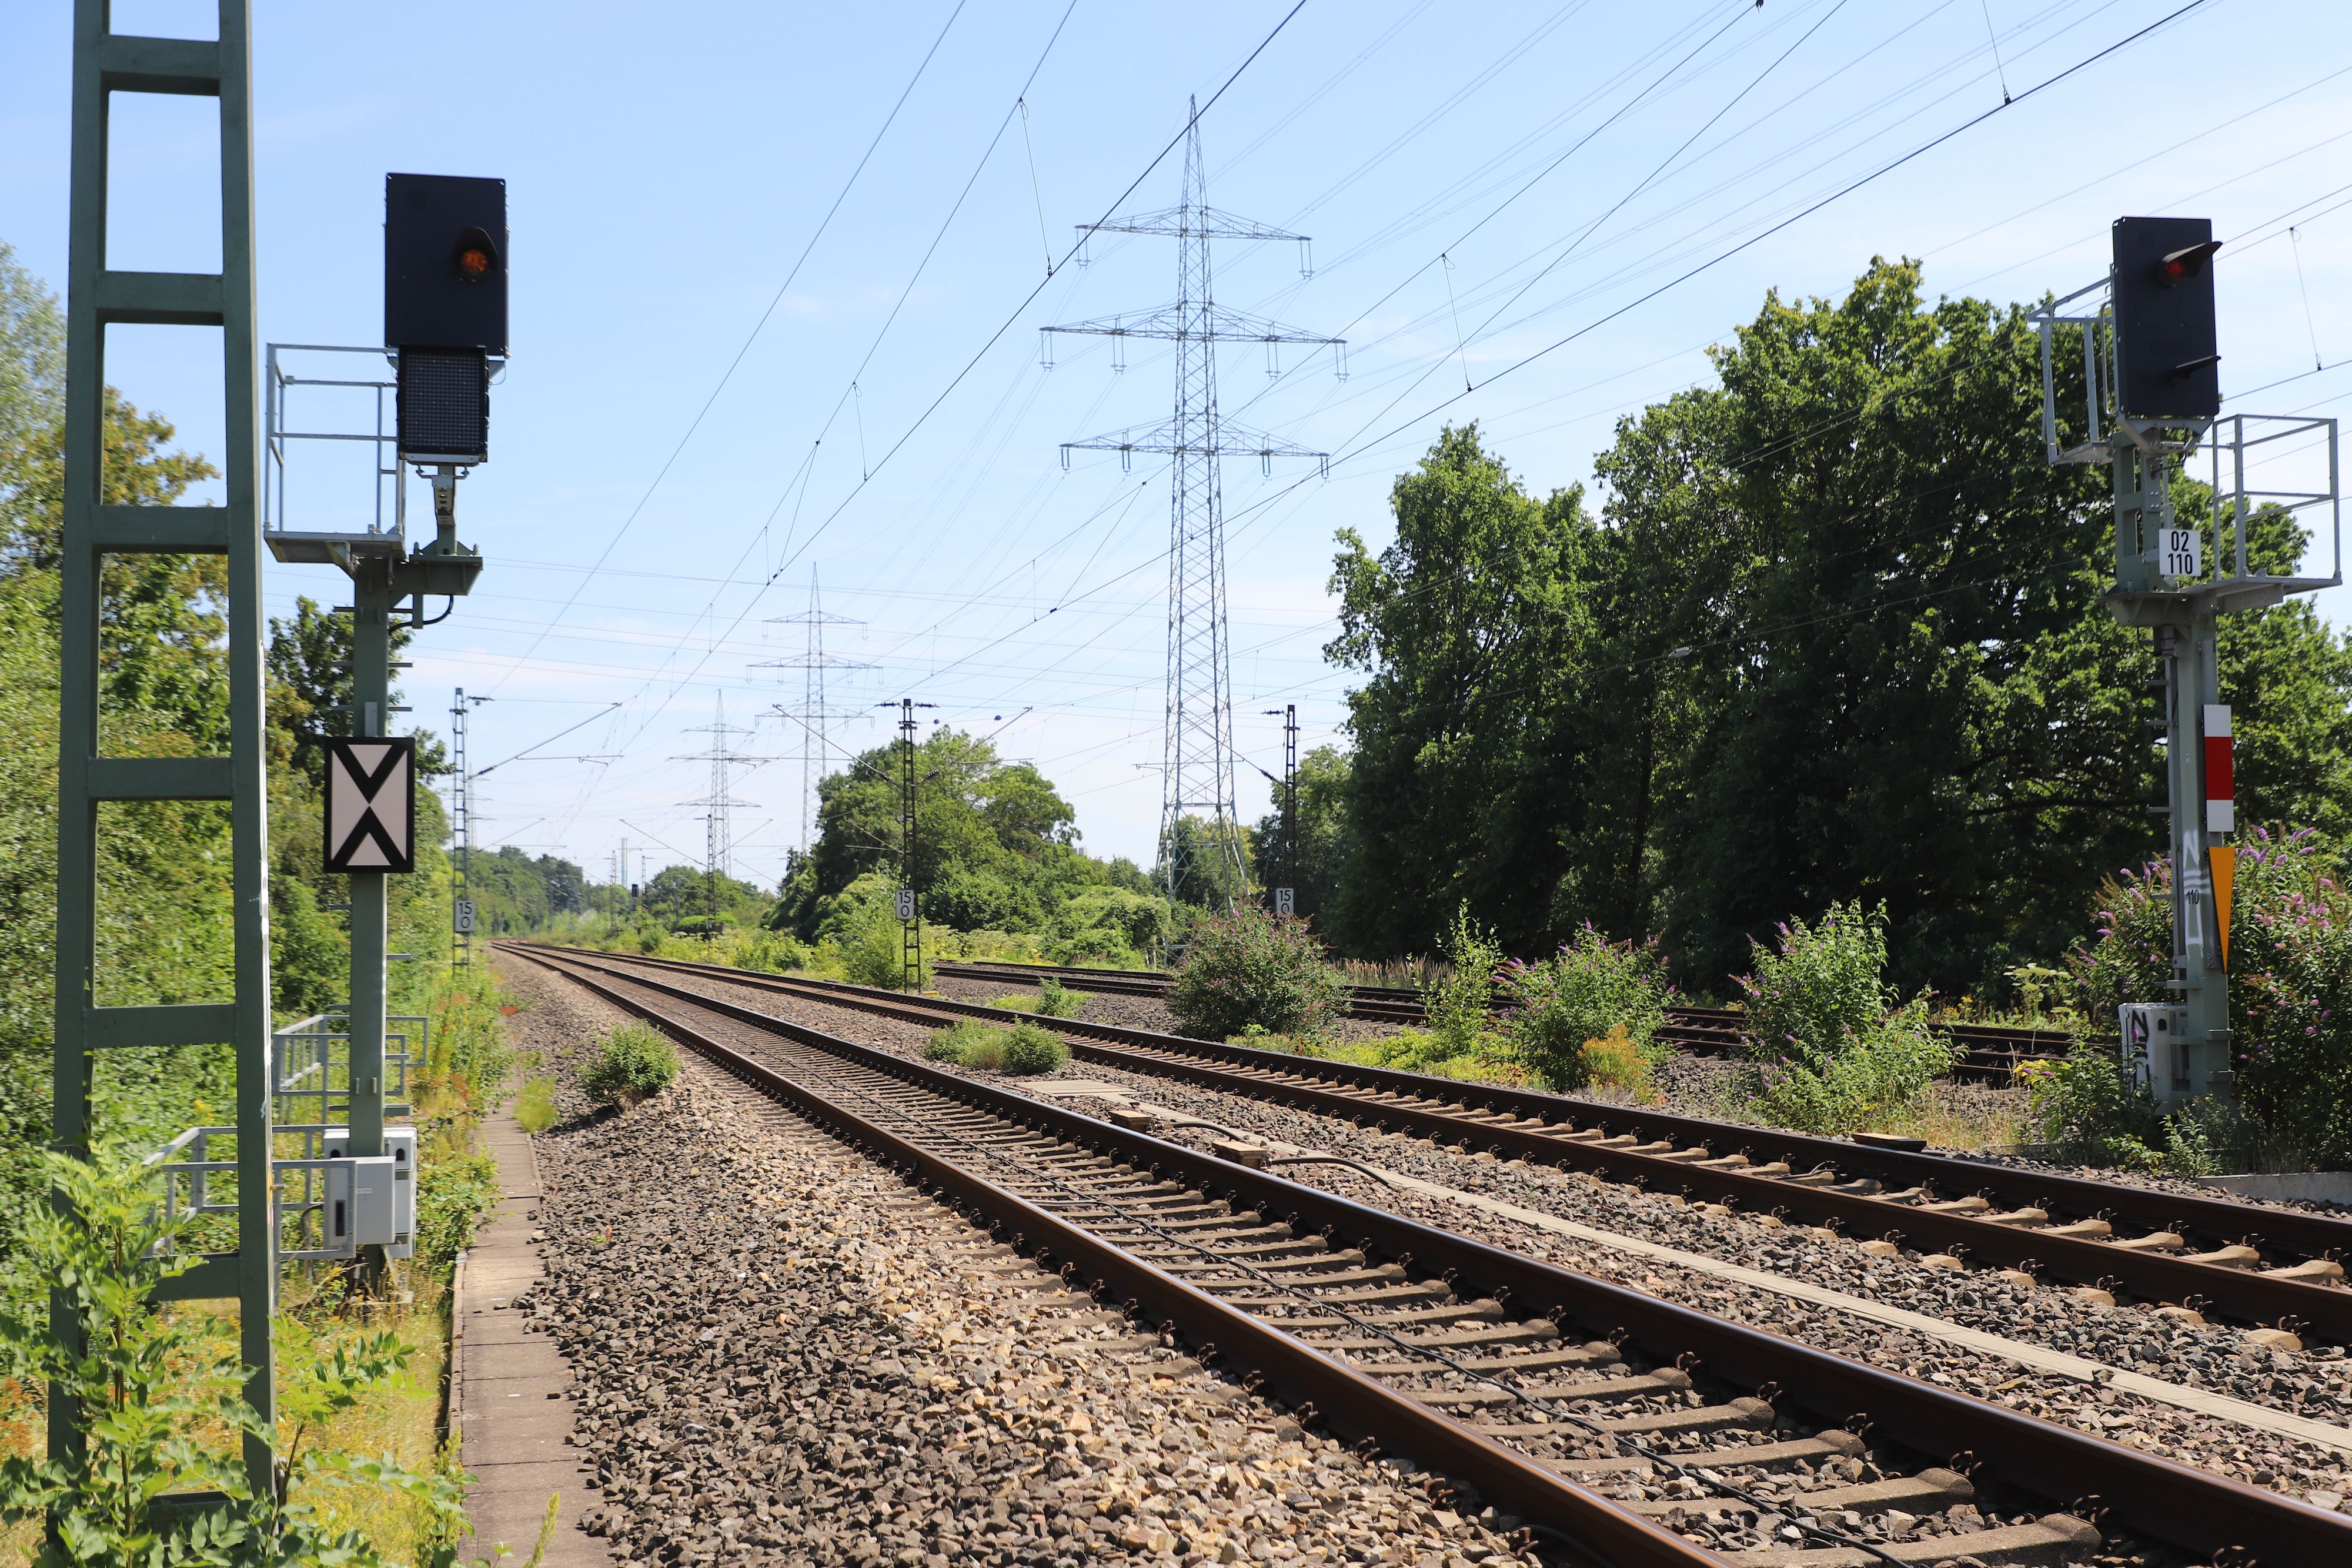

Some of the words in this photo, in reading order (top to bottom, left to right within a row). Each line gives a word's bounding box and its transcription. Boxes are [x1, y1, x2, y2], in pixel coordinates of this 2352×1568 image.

[2171, 531, 2189, 552] 02
[2167, 553, 2193, 574] 110
[898, 891, 911, 904] 15
[1279, 890, 1291, 902] 15
[2186, 889, 2199, 905] 110
[459, 902, 473, 915] 15
[900, 905, 910, 917] 0
[1281, 903, 1289, 915] 0
[460, 916, 471, 929] 0
